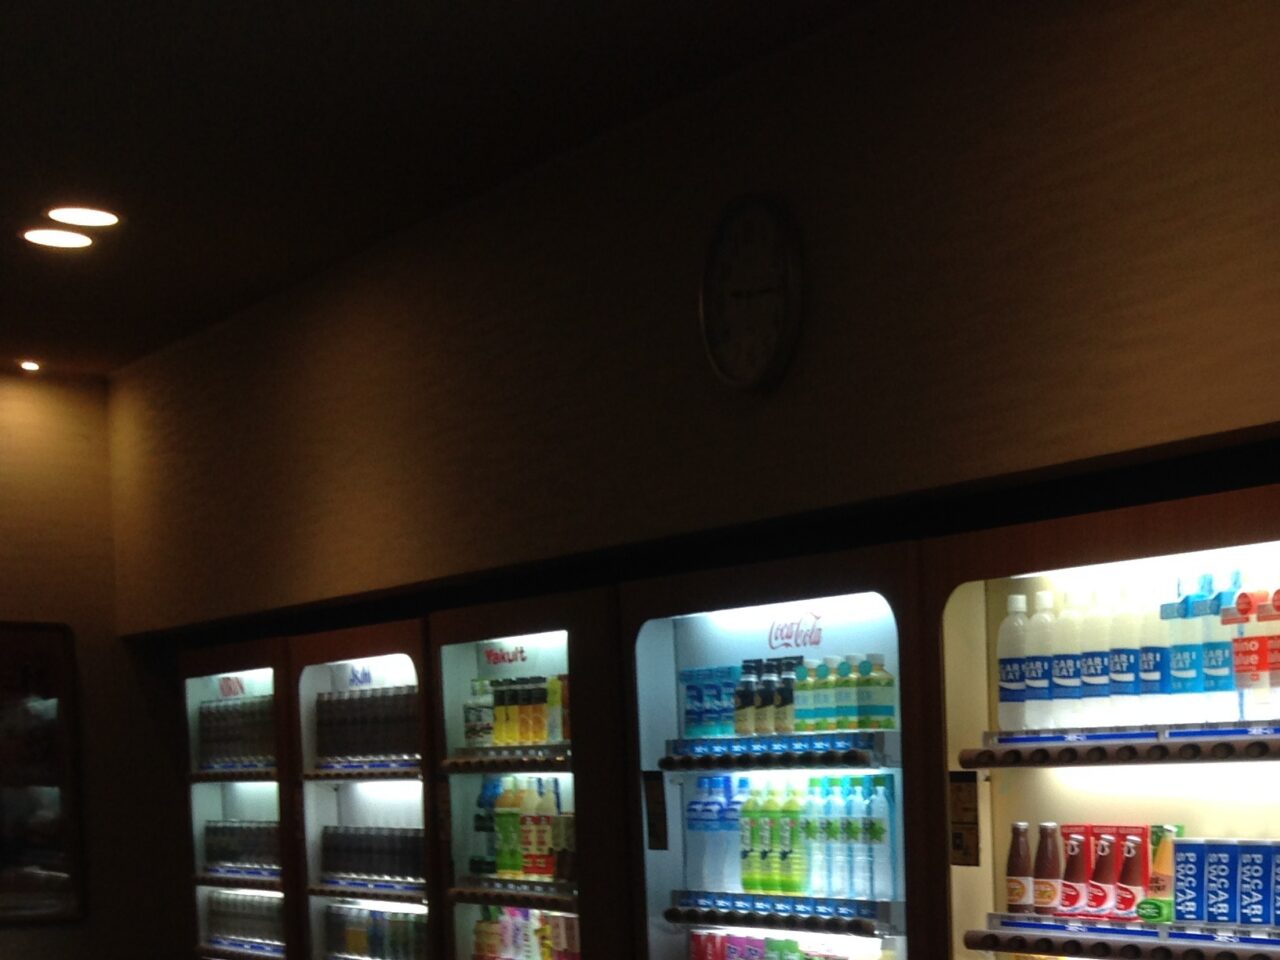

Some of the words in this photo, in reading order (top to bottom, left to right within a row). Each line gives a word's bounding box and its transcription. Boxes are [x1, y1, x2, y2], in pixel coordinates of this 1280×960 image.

[485, 647, 527, 665] Yakult
[1185, 852, 1197, 919] POCARI
[1217, 853, 1230, 921] POCARI
[1251, 853, 1263, 923] POCARI
